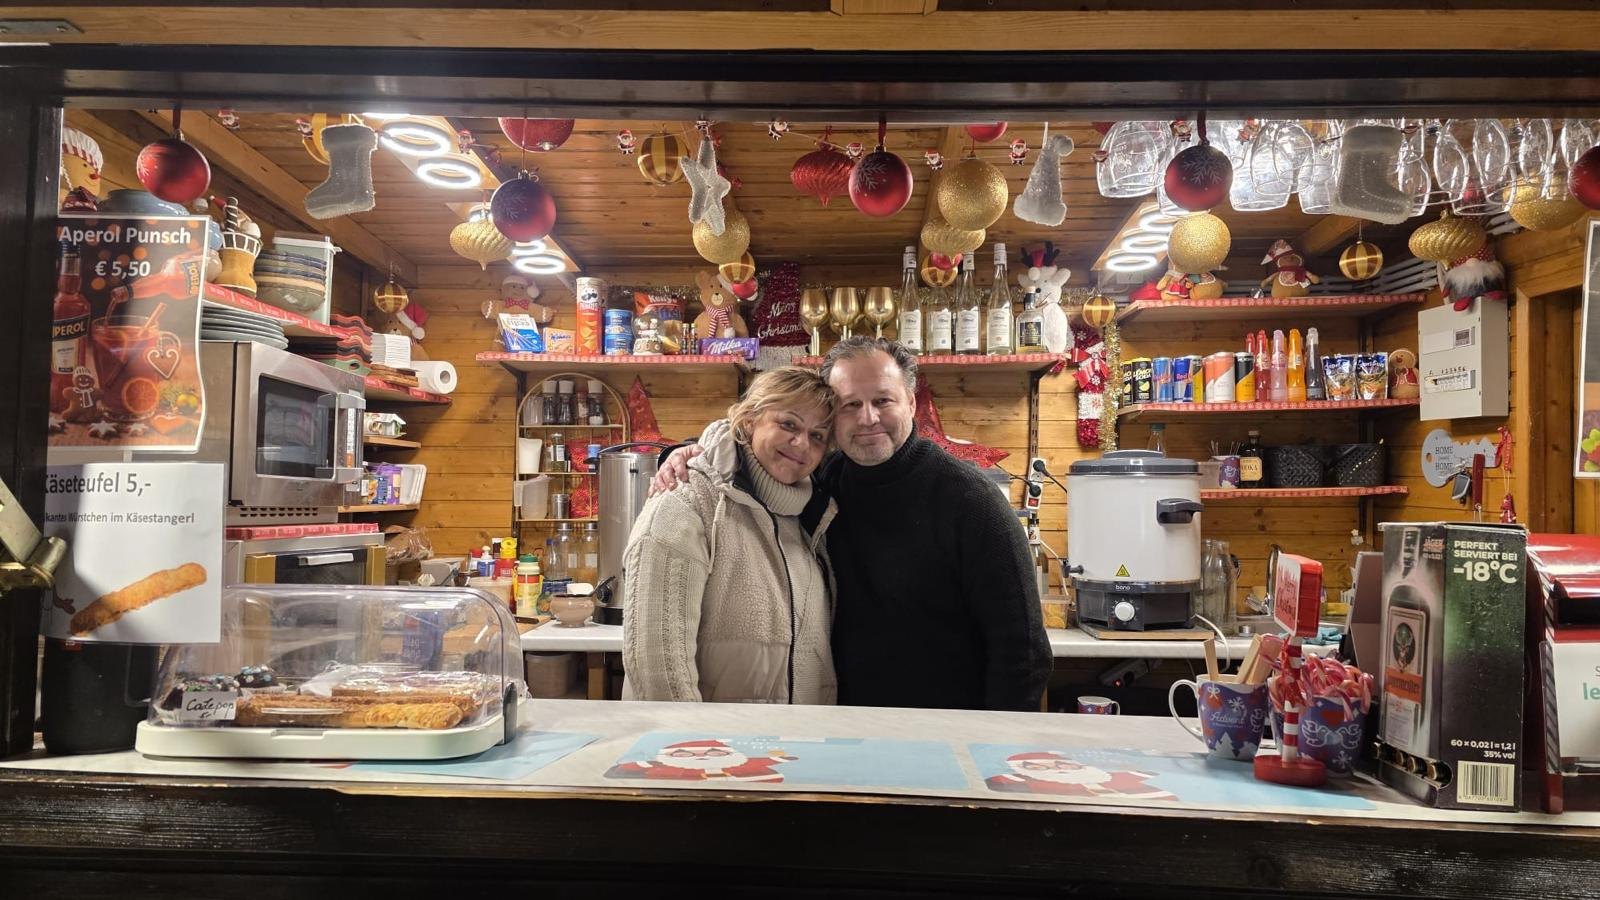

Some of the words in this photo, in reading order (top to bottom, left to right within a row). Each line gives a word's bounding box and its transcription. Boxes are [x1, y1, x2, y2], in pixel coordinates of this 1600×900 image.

[58, 226, 120, 245] Aperol
[126, 227, 191, 245] Punsch
[95, 261, 107, 276] €
[111, 261, 150, 278] 5,50
[707, 340, 742, 354] Milka
[126, 473, 151, 496] 5,-
[68, 511, 107, 523] Würstchen
[110, 512, 123, 523] im
[126, 512, 195, 526] Käsestangerl
[1454, 540, 1498, 550] PERFEKT
[1453, 550, 1500, 560] SERVIERT
[1501, 552, 1518, 561] BEI
[1453, 560, 1518, 584] -18°C
[1451, 739, 1463, 747] 60
[1470, 740, 1489, 749] 0,02
[1501, 742, 1512, 751] 1,2
[1483, 750, 1502, 759] 35%
[1502, 751, 1516, 760] vol
